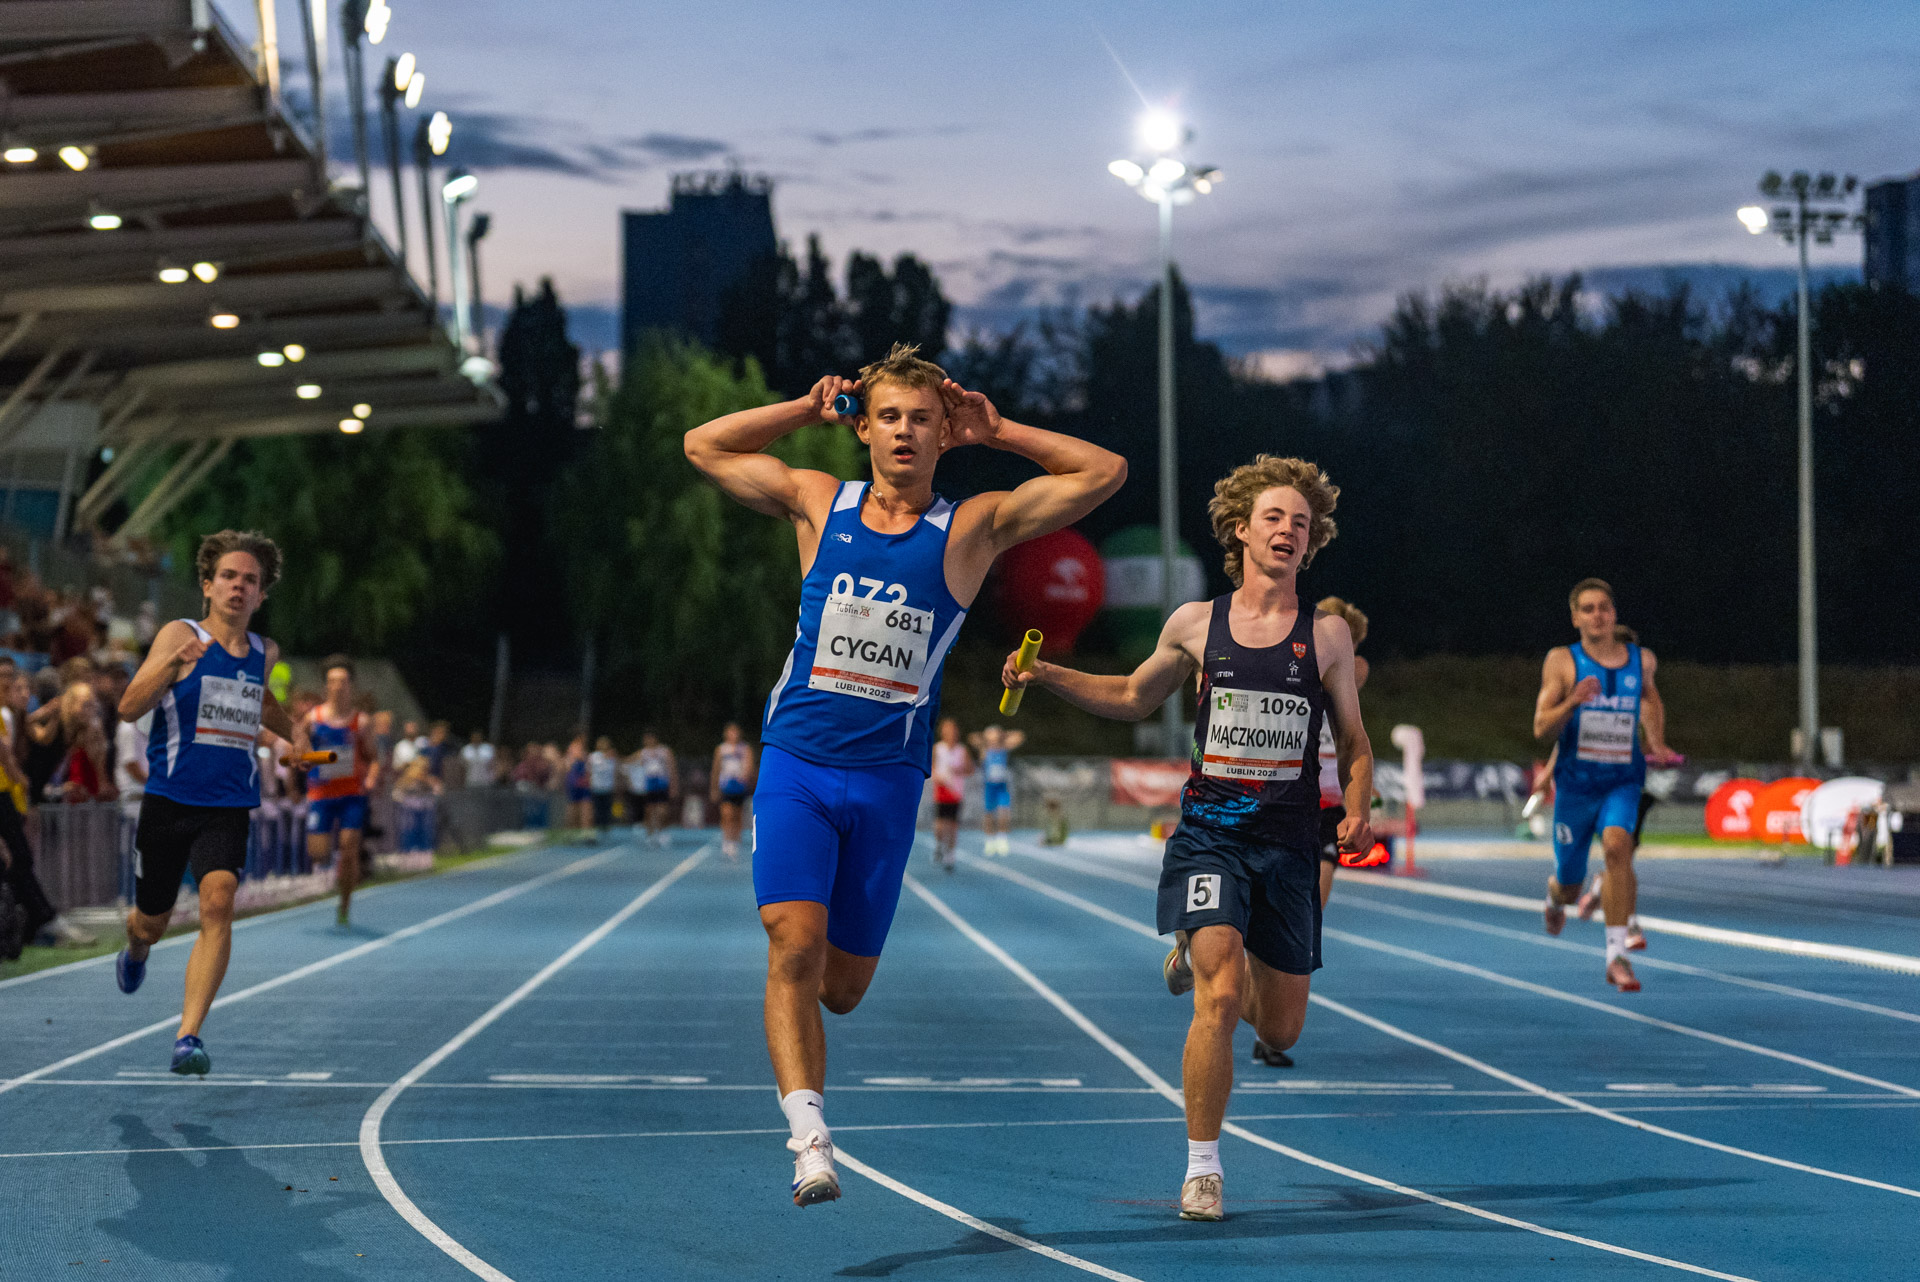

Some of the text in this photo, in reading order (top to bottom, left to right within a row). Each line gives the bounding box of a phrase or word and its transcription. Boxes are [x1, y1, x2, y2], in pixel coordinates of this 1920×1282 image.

[885, 610, 923, 635] 681
[830, 635, 913, 671] CYGAN
[241, 686, 261, 702] 641
[835, 681, 868, 694] LUBLIN
[868, 688, 892, 700] 2025
[1260, 697, 1309, 716] 1096
[1210, 723, 1304, 750] MĄCZKOWIAK
[1226, 767, 1278, 777] LUBLIN 2025
[1193, 876, 1212, 907] 5
